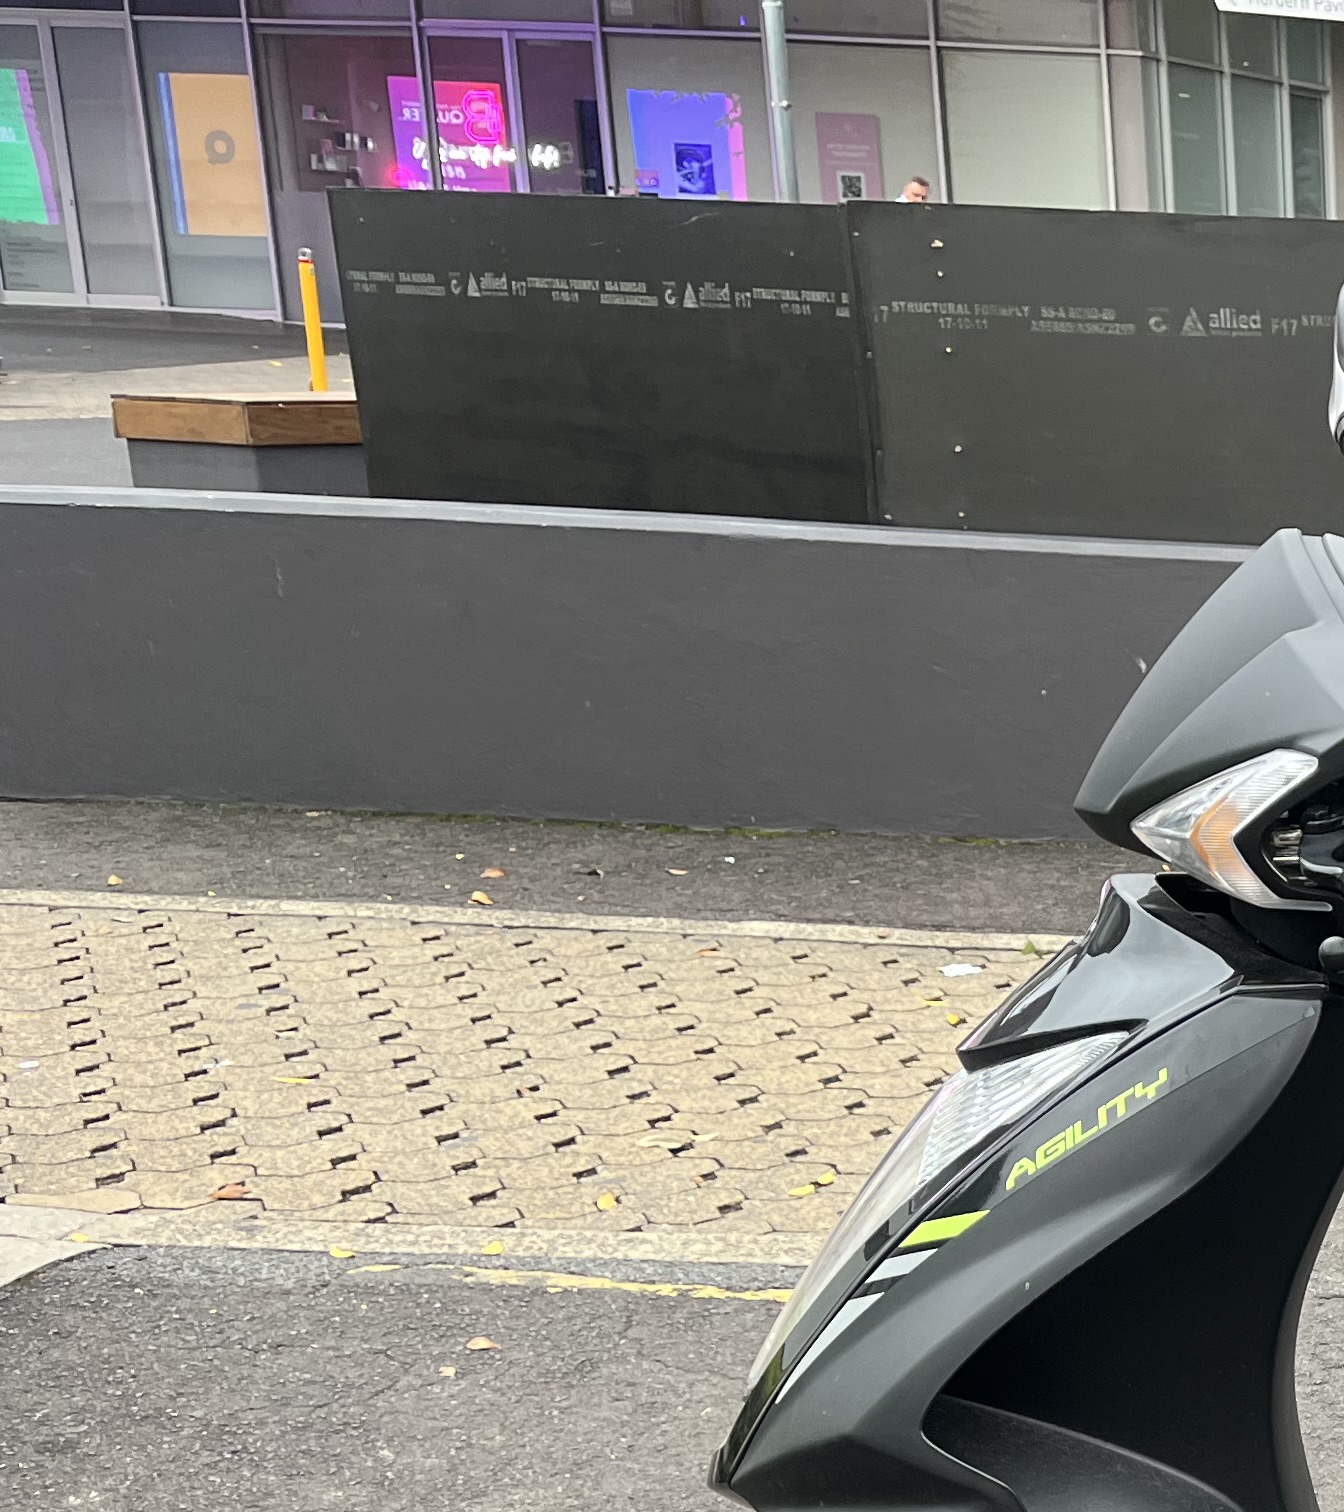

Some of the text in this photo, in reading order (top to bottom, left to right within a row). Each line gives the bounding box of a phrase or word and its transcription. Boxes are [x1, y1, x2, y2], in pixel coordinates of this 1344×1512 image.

[699, 281, 731, 301] allied
[891, 300, 972, 315] STRUCTURAL
[1208, 306, 1262, 330] allied
[1270, 317, 1298, 337] F17
[1005, 1066, 1168, 1191] AGILITY
